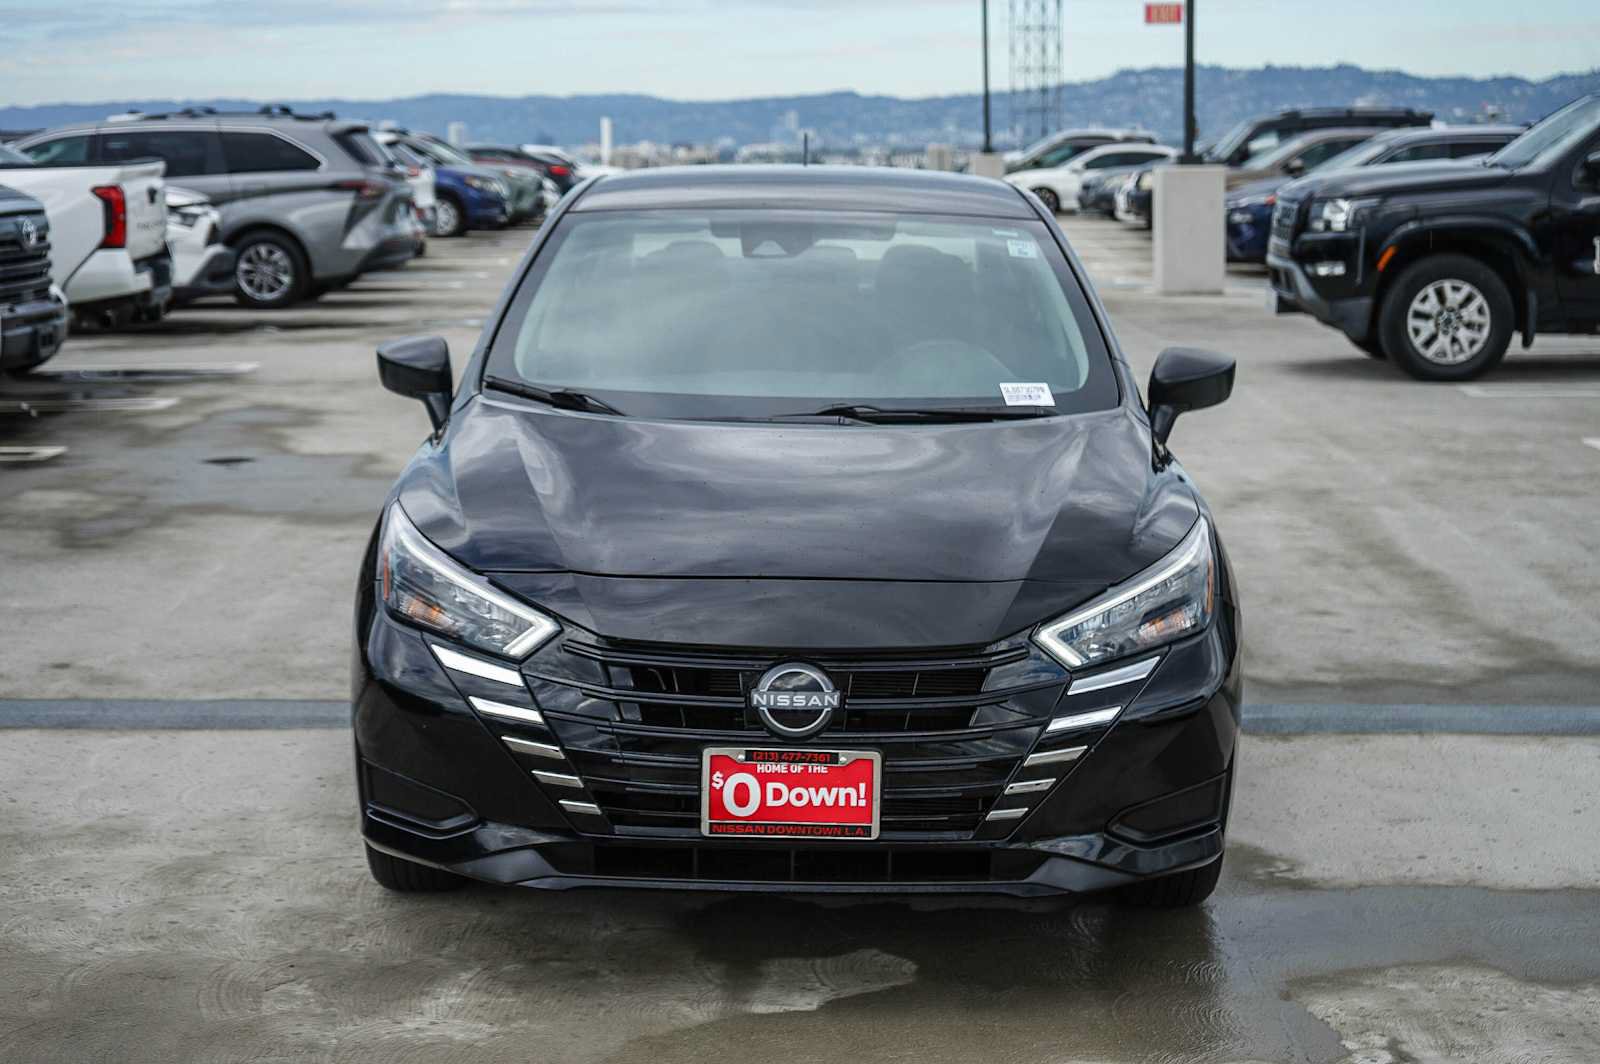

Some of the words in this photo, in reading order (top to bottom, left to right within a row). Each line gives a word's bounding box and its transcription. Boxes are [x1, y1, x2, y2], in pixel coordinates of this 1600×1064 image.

[753, 693, 838, 707] NISSAN
[752, 751, 779, 762] (213)
[781, 752, 831, 763] 477-7361
[757, 764, 788, 774] HOME
[790, 764, 804, 774] OF
[807, 764, 829, 774] THE
[766, 782, 867, 807] Down!
[711, 823, 767, 834] NISSAN
[767, 824, 842, 836] DOWNTOWN
